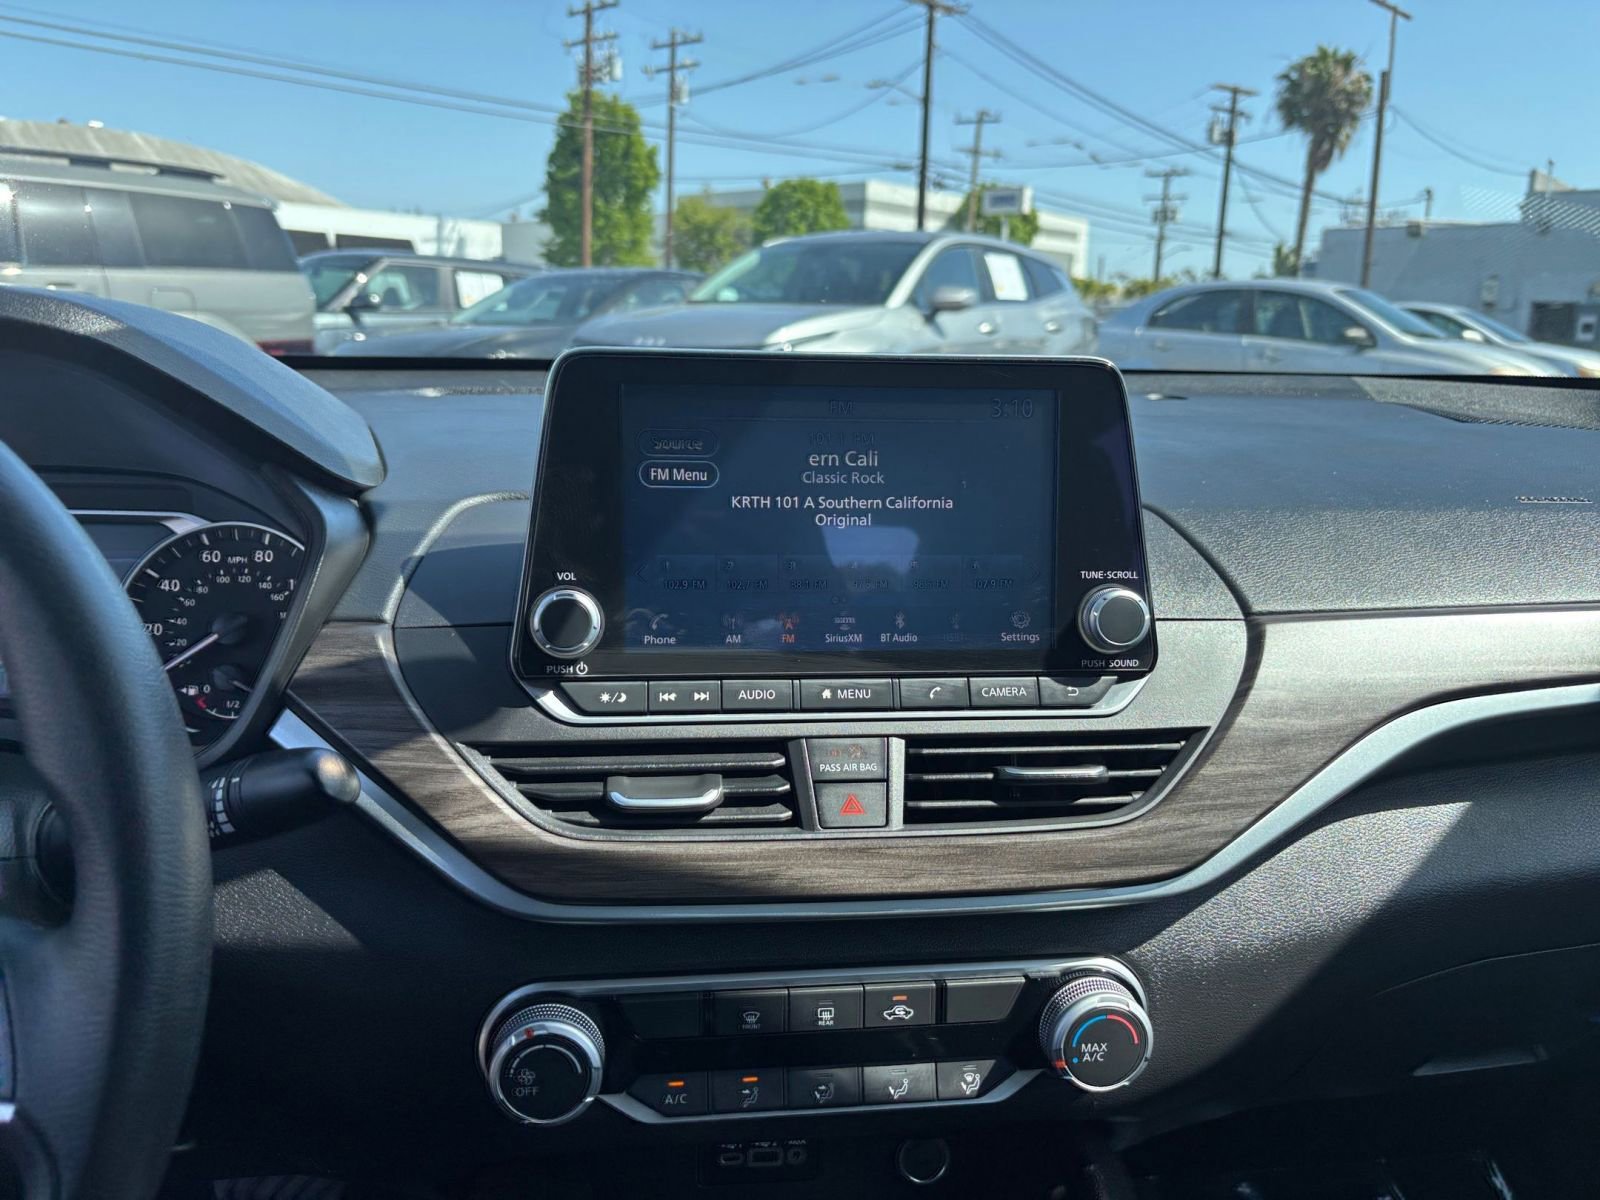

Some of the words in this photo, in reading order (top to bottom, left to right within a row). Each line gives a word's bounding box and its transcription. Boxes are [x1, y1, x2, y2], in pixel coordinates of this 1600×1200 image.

[991, 398, 1033, 418] 3:10
[809, 453, 839, 467] ern
[845, 450, 878, 467] Cali
[650, 468, 669, 481] FM
[673, 467, 707, 481] Menu
[802, 471, 848, 485] Classic
[851, 471, 885, 485] Rock
[731, 496, 770, 509] KRTH
[775, 496, 799, 509] 101
[803, 496, 815, 509] A
[818, 496, 882, 509] Southern
[886, 496, 953, 509] California
[815, 513, 871, 528] Original
[201, 550, 222, 563] 60
[227, 556, 248, 565] MPH
[253, 550, 273, 563] 80
[216, 576, 230, 584] 100
[238, 575, 251, 583] 120
[557, 572, 576, 581] VOL
[158, 579, 180, 592] 40
[692, 579, 705, 590] FM
[644, 634, 677, 645] Phone
[725, 634, 742, 643] AM
[781, 634, 795, 643] FM
[825, 633, 862, 643] SiriusXM
[880, 633, 891, 643] BT
[893, 632, 918, 643] Audio
[1001, 632, 1040, 644] Settings
[1081, 659, 1105, 668] PUSH
[1109, 659, 1139, 668] SOUND
[546, 665, 573, 674] PUSH
[738, 689, 776, 701] AUDIO
[837, 688, 871, 701] MENU
[981, 686, 1027, 698] CAMERA
[226, 701, 240, 709] 1/2
[819, 763, 841, 772] PASS
[843, 763, 858, 771] AIR
[859, 763, 878, 771] BAG
[1081, 1042, 1107, 1052] MAX
[1082, 1052, 1104, 1062] A/C
[511, 1087, 539, 1097] OFF
[663, 1093, 688, 1104] A/C
